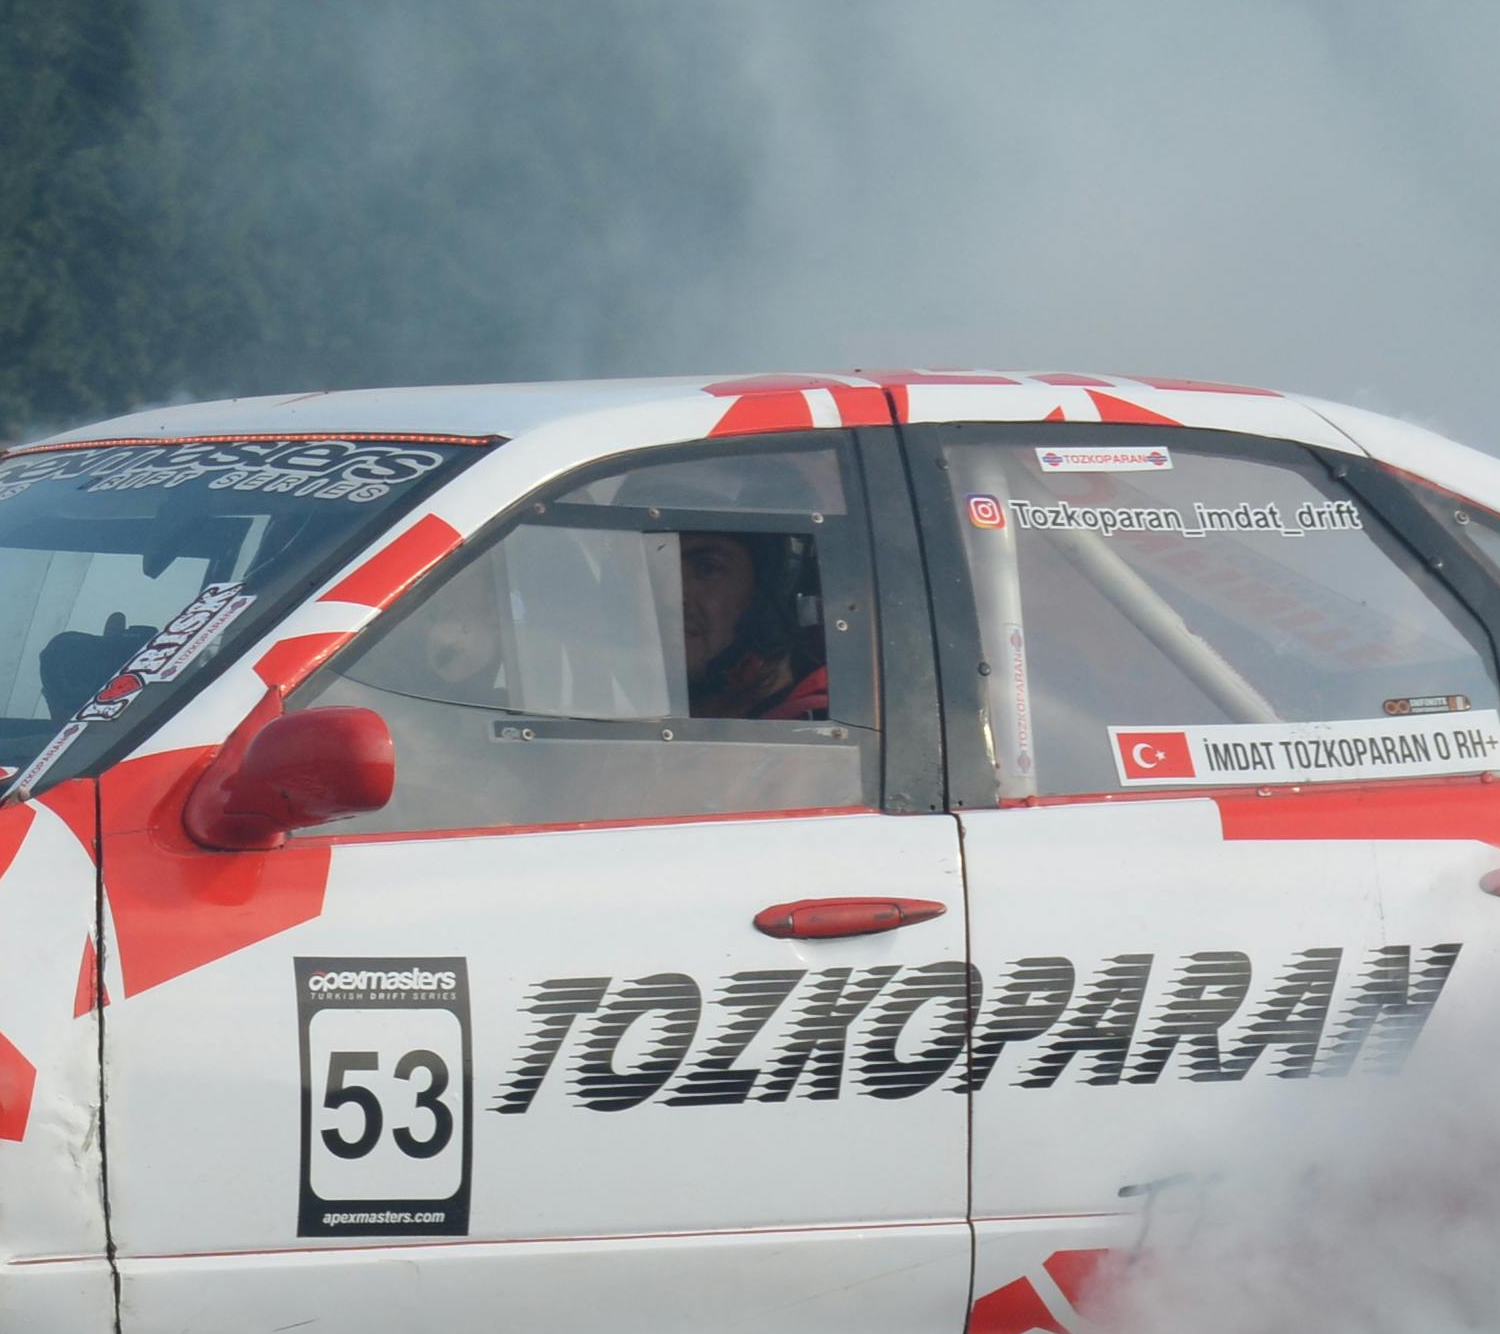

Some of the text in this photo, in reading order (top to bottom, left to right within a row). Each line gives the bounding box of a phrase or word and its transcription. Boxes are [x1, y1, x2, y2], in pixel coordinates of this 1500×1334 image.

[1064, 454, 1146, 464] TOZKOPARAN
[208, 470, 390, 503] SERIES
[1009, 499, 1362, 537] Tozkoparan_imdat_drift
[120, 583, 246, 675] RISK
[1202, 737, 1274, 772] İMDAT
[1279, 732, 1432, 769] TOZKOPARAN
[1456, 728, 1499, 759] RH+
[308, 967, 457, 993] apexmasters
[310, 992, 457, 1001] TURKISH DRIFT SERIES
[484, 942, 1464, 1115] TOZKOPARAN
[320, 1048, 454, 1160] 53
[322, 1209, 446, 1227] apexmasters.com
